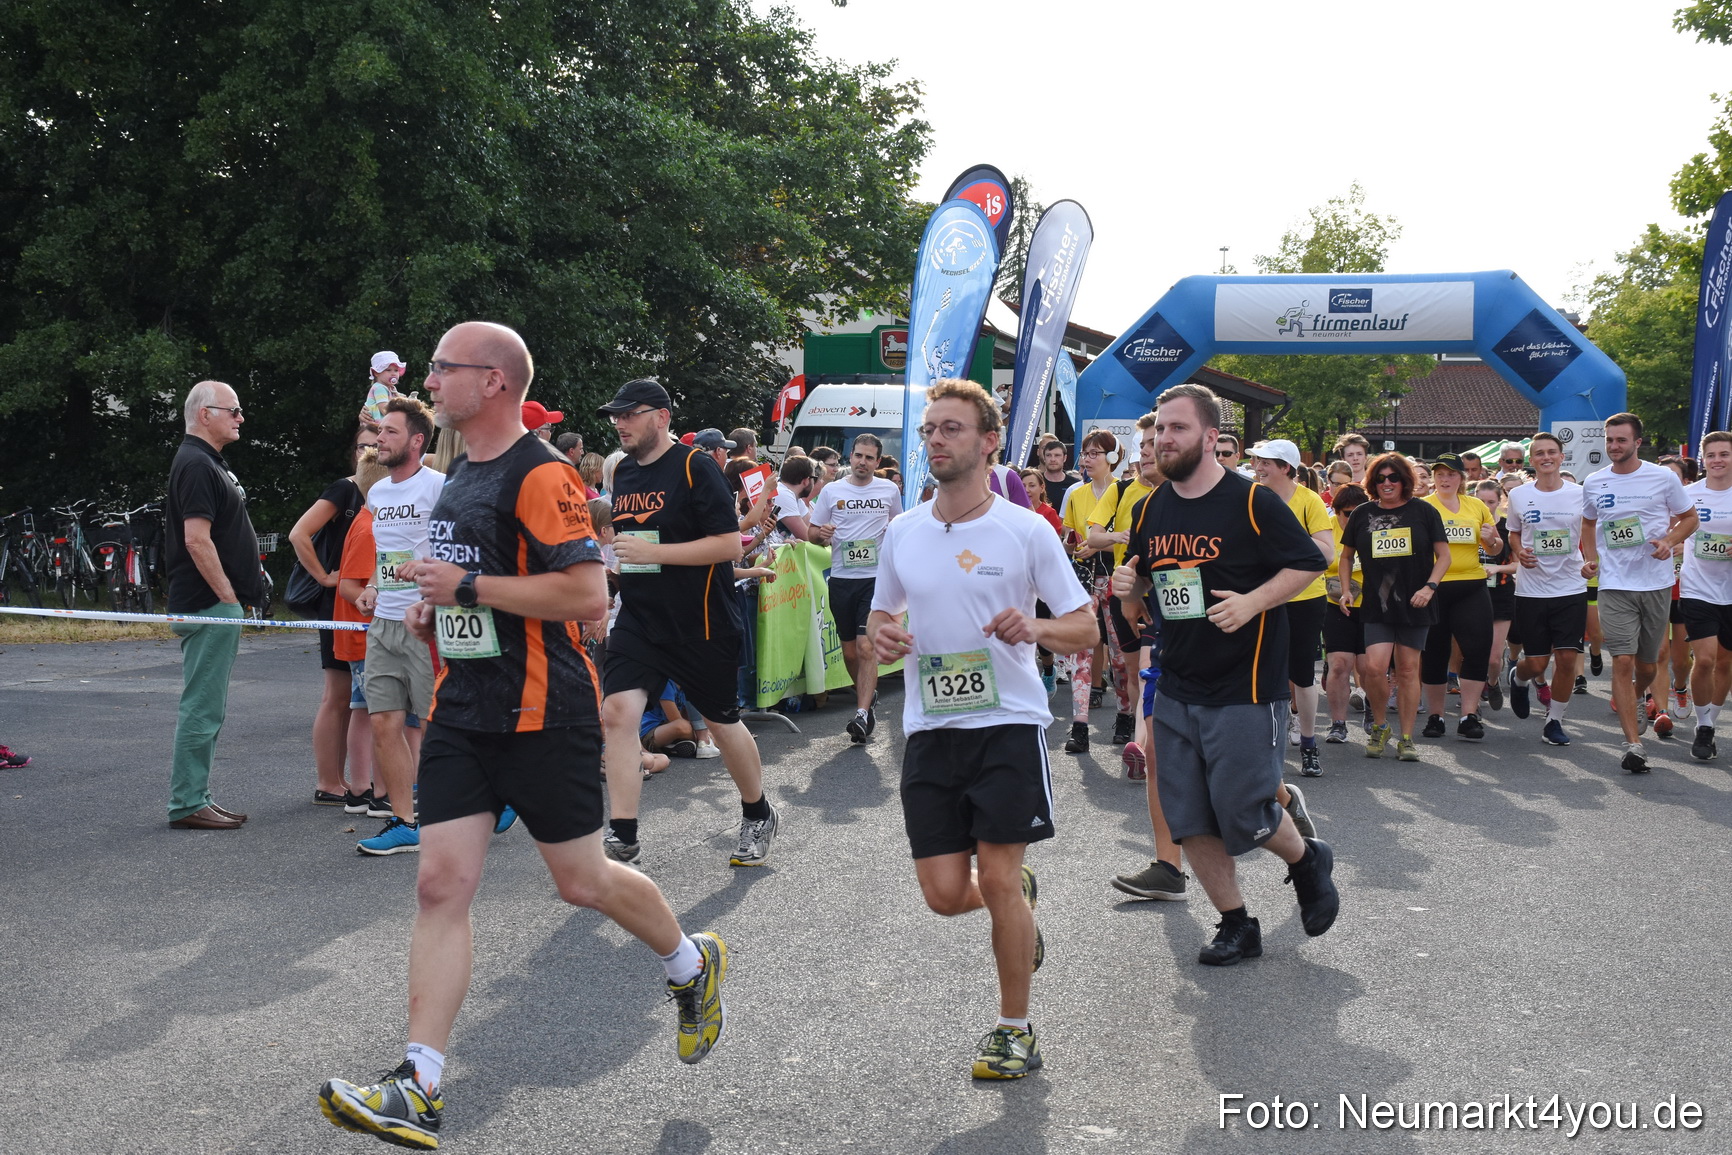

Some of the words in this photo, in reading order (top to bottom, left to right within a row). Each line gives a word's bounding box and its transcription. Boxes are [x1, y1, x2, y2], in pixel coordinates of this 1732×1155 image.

[1041, 223, 1073, 309] Fischer
[1055, 235, 1079, 305] AUTOMOBILE
[1312, 313, 1409, 331] firmenlauf
[1133, 346, 1183, 357] Fischer
[1510, 344, 1525, 352] und
[1526, 342, 1541, 350] das
[807, 406, 847, 415] abavent
[618, 491, 666, 512] WINGS
[847, 499, 885, 510] GRADL
[377, 503, 421, 521] GRADL
[428, 520, 455, 541] ECK
[1444, 527, 1472, 537] 2005
[1610, 527, 1634, 541] 346
[1153, 533, 1222, 559] WINGS
[1376, 537, 1407, 550] 2008
[1541, 538, 1563, 549] 348
[1702, 541, 1726, 554] 340
[848, 548, 870, 561] 942
[381, 565, 397, 580] 94
[1162, 587, 1190, 607] 286
[439, 613, 483, 639] 1020
[927, 672, 986, 698] 1328
[952, 694, 983, 702] Sebastian
